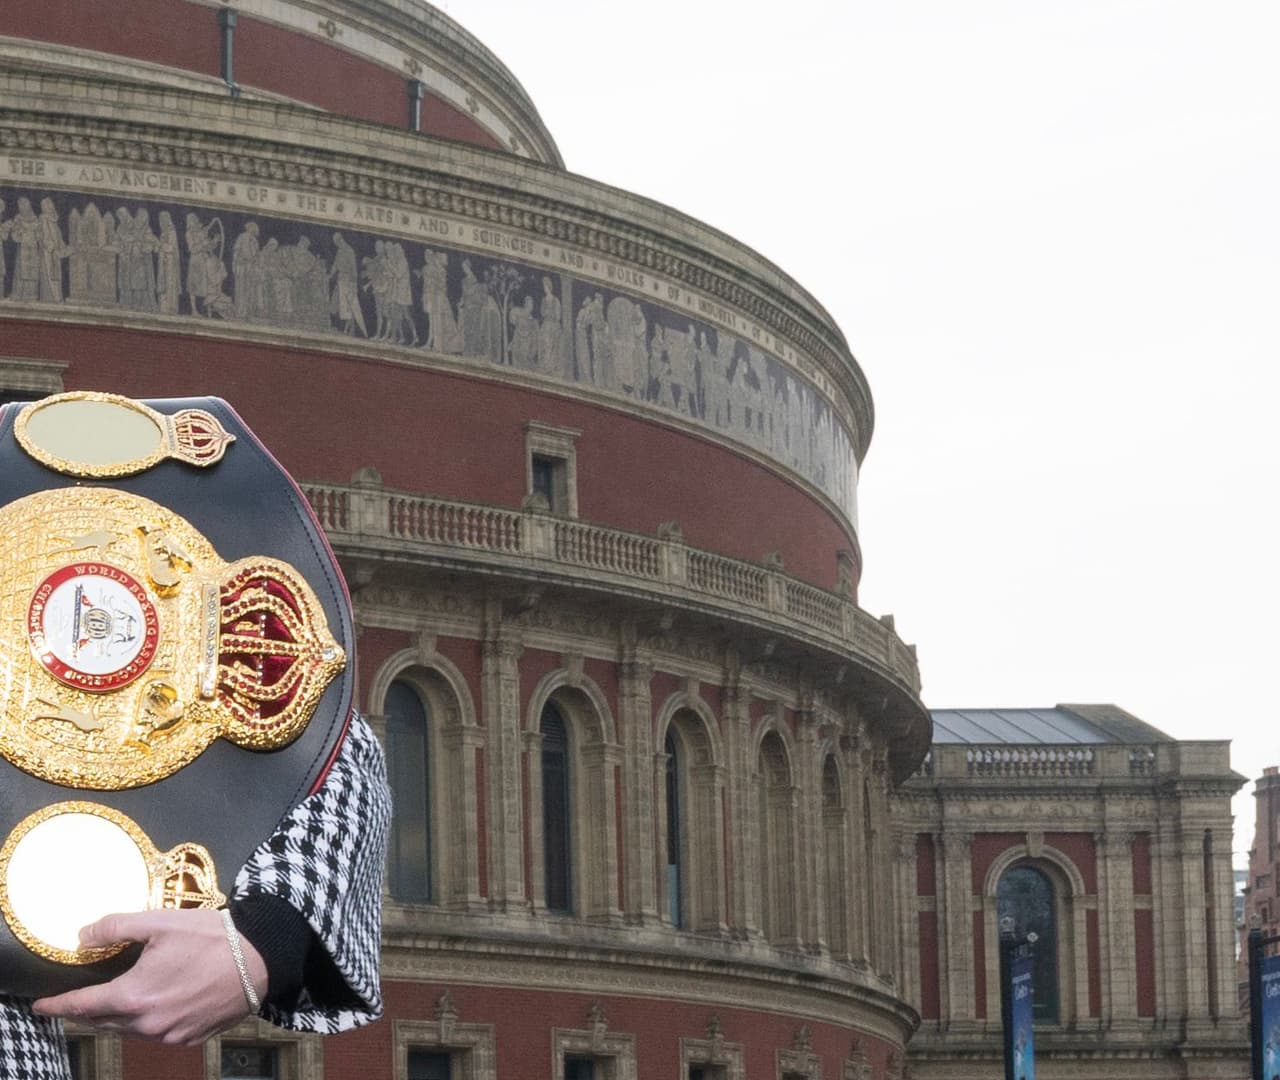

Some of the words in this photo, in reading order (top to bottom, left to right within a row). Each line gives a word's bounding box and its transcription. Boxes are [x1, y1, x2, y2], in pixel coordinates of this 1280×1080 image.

[7, 159, 46, 177] THE
[78, 166, 217, 195] ADVANCEMENT
[246, 188, 269, 203] OF
[295, 194, 328, 213] THE
[352, 205, 394, 224] ARTS
[418, 217, 450, 235] AND
[73, 564, 129, 584] WORLD
[130, 584, 157, 636] BOXING
